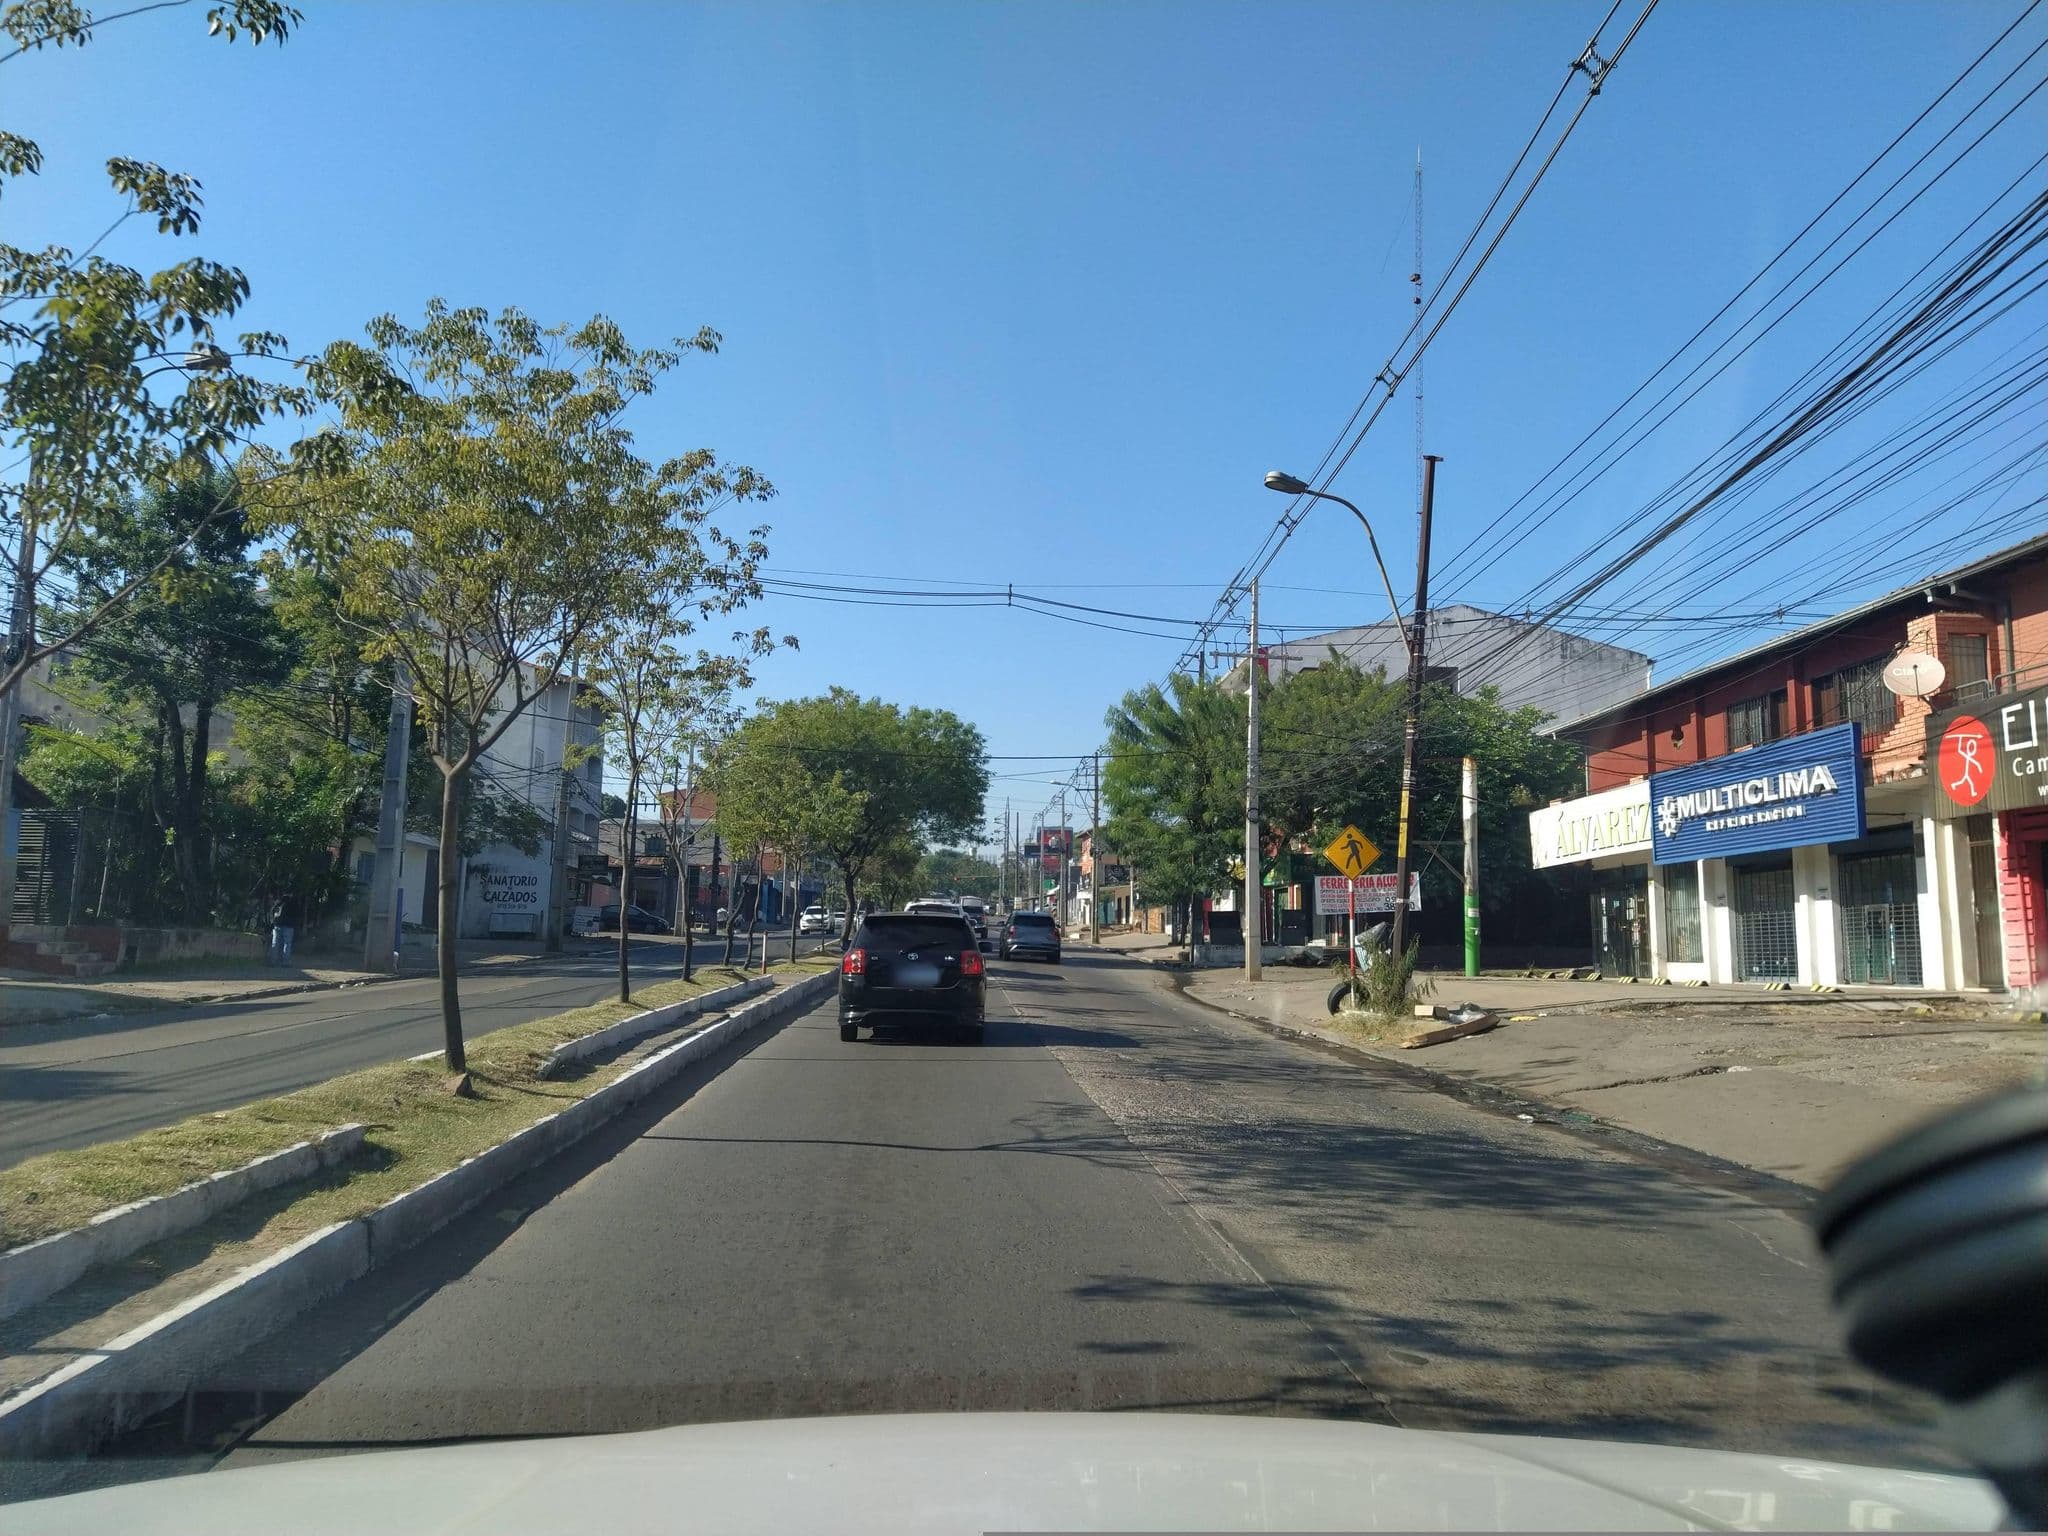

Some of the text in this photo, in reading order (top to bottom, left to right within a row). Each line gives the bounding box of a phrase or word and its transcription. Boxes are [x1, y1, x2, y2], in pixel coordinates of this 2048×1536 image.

[1676, 765, 1838, 820] MULTICLIMA
[1555, 802, 1652, 858] ÁLVAREZ
[480, 873, 537, 887] SANATORIO
[1320, 876, 1375, 889] FERREERIA
[483, 891, 537, 903] CALZADOS
